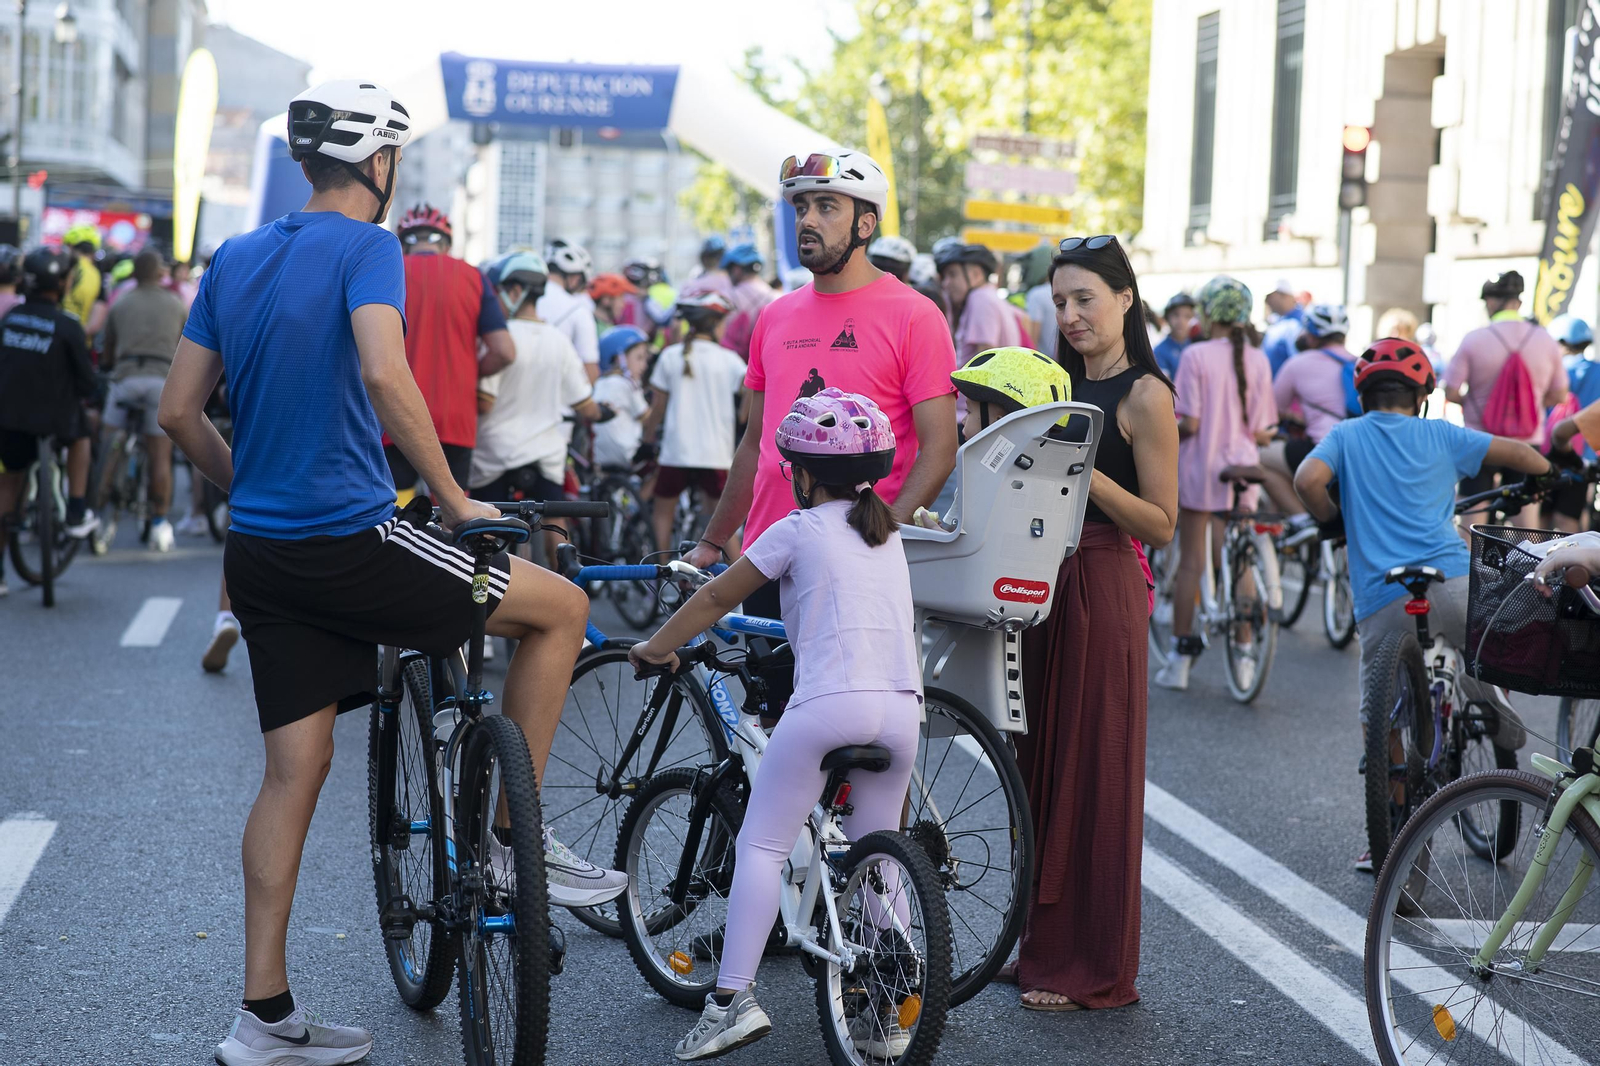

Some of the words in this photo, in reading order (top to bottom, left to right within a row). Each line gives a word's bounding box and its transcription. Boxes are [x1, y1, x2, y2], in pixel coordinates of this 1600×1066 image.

[507, 68, 654, 98] DEPUTACIÓN
[504, 91, 615, 118] OURENSE
[376, 130, 397, 140] ABUS
[1000, 583, 1046, 597] Polisport
[745, 618, 771, 627] MATRIX
[643, 675, 661, 711] LOO
[637, 706, 656, 736] Carbon
